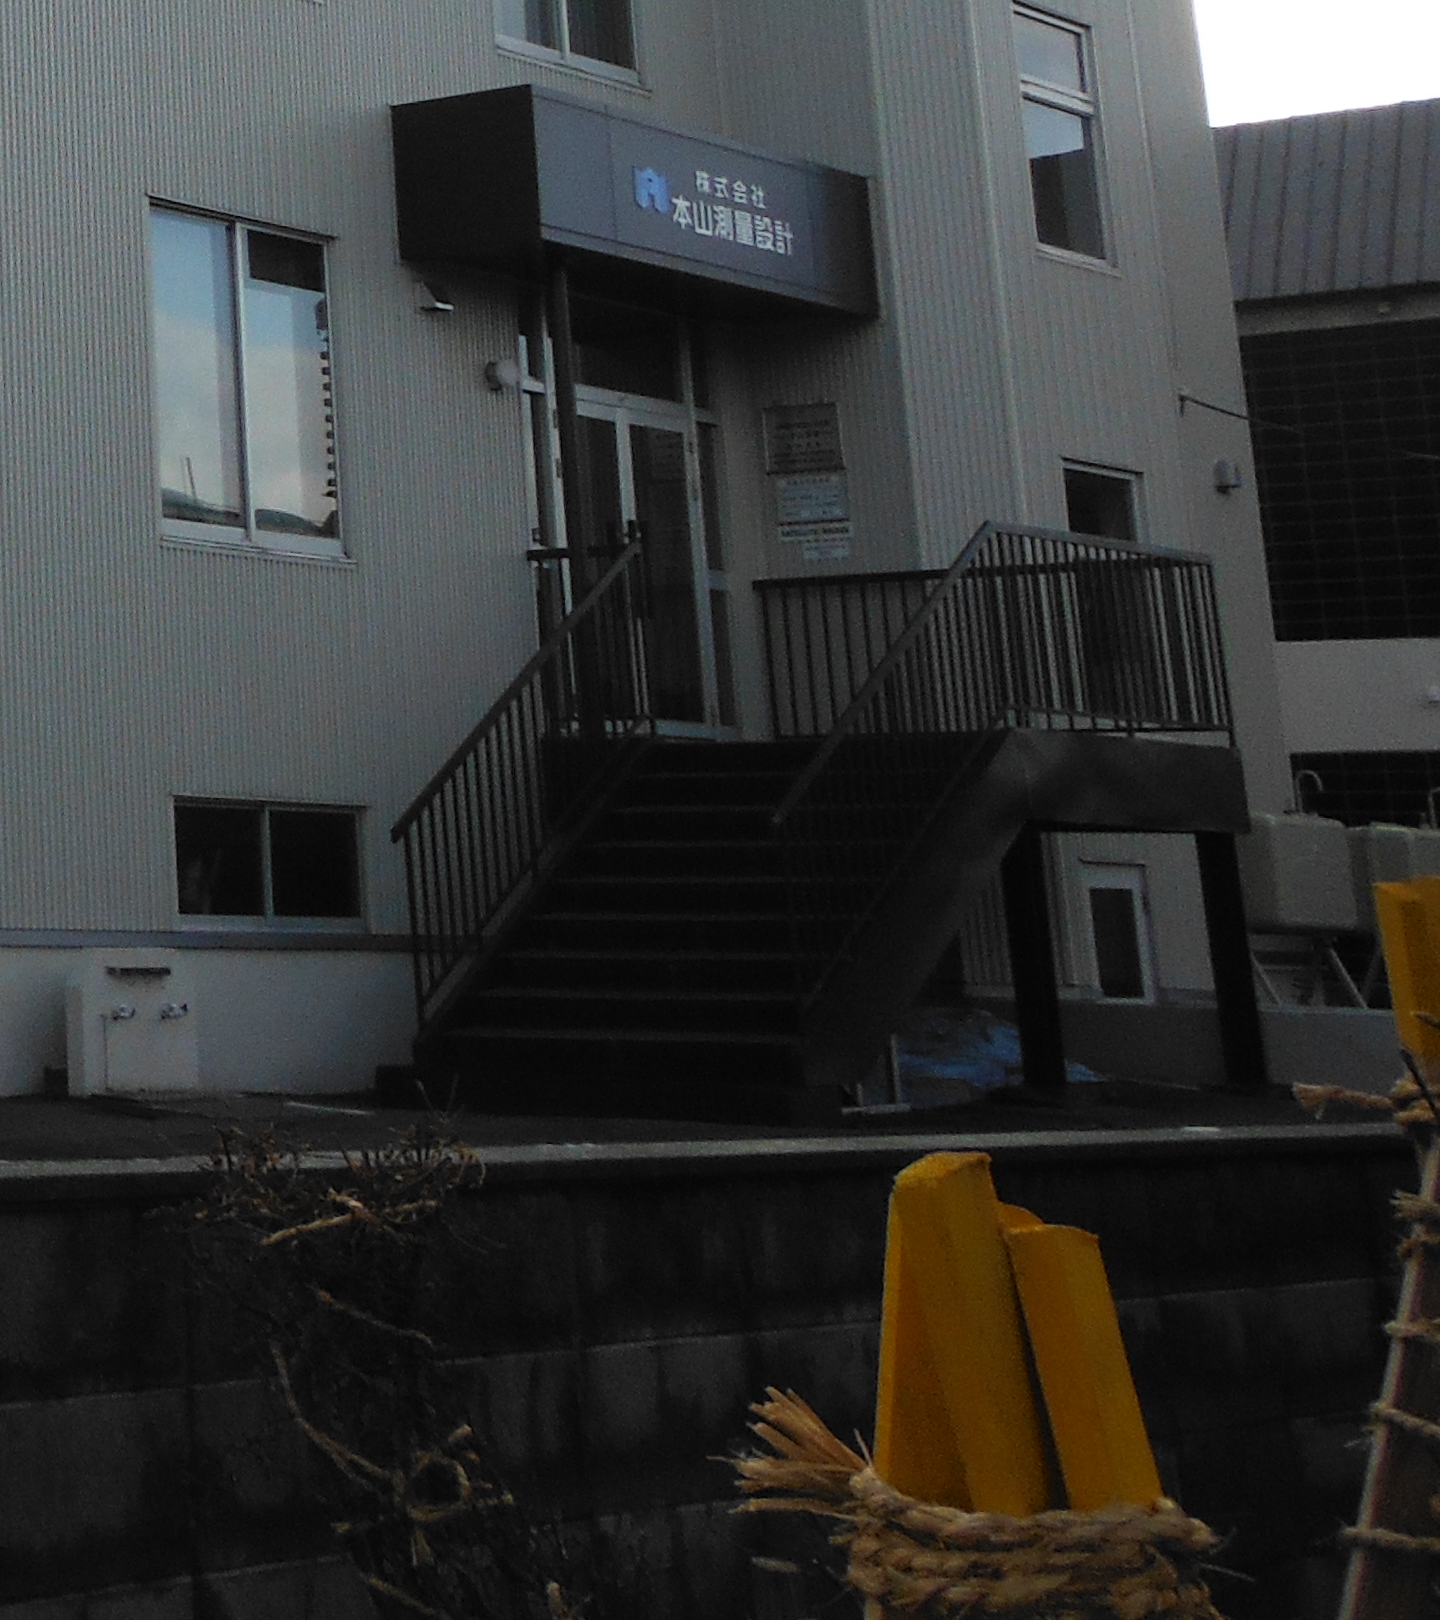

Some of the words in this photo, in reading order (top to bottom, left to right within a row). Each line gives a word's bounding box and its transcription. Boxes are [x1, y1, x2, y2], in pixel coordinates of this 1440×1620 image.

[694, 169, 767, 209] 株式会社
[671, 194, 794, 256] 本山測量設計
